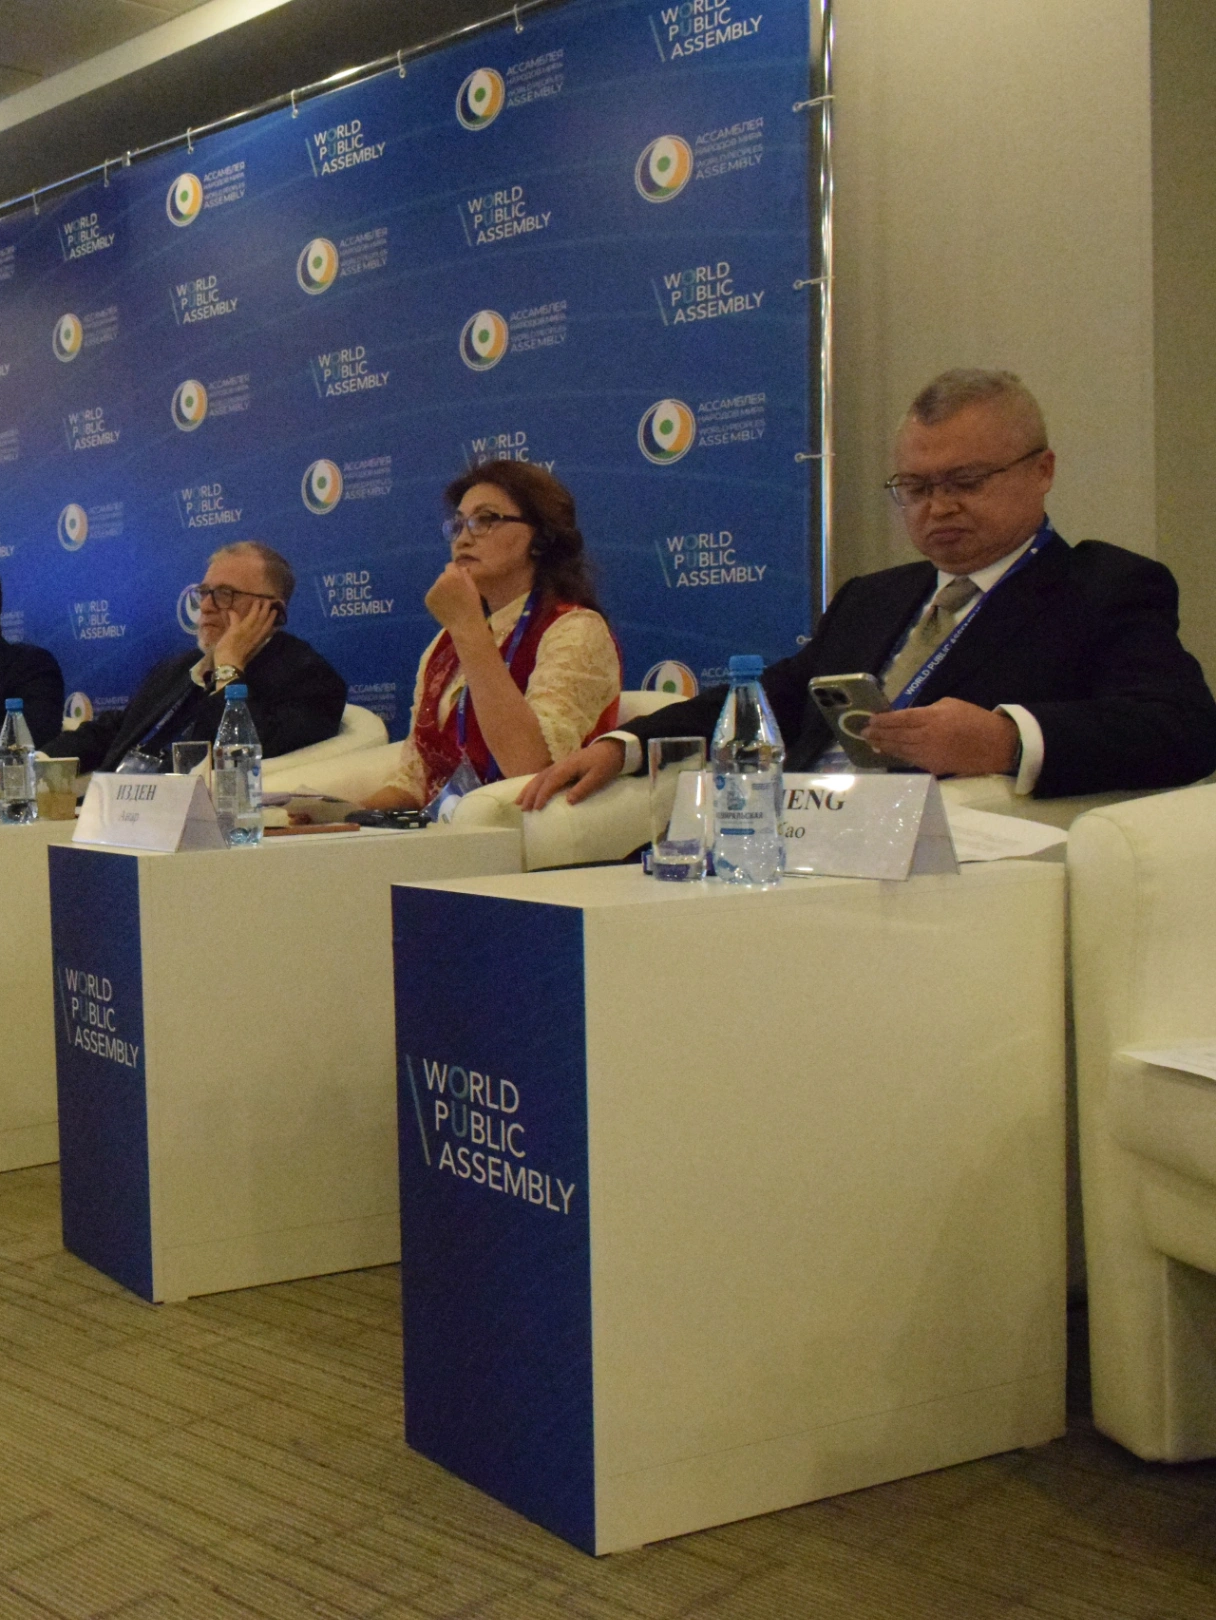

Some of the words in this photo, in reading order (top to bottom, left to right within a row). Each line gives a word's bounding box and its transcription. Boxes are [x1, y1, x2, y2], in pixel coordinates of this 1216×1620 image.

[661, 0, 725, 25] WORLD
[668, 7, 732, 41] PUBLIC
[670, 14, 763, 60] ASSEMBLY
[314, 119, 361, 147] WORLD
[319, 134, 364, 161] PUBLIC
[321, 141, 386, 176] ASSEMBLY
[695, 154, 763, 181] ASSEMBLY
[468, 186, 523, 213] WORLD
[64, 213, 98, 235] WORLD
[474, 202, 526, 230] PUBLIC
[68, 225, 100, 246] PUBLIC
[476, 211, 552, 246] ASSEMBLY
[69, 233, 115, 259] ASSEMBLY
[176, 275, 217, 297] WORLD
[664, 262, 730, 289] WORLD
[181, 289, 219, 311] PUBLIC
[671, 278, 733, 307] PUBLIC
[183, 298, 238, 324] ASSEMBLY
[673, 290, 765, 325] ASSEMBLY
[318, 346, 365, 368] WORLD
[324, 361, 368, 383] PUBLIC
[326, 371, 390, 397] ASSEMBLY
[69, 407, 103, 425] WORLD
[73, 420, 105, 438] PUBLIC
[74, 430, 121, 450] ASSEMBLY
[698, 428, 765, 447] ASSEMBLY
[471, 431, 526, 453] WORLD
[182, 483, 222, 501] WORLD
[186, 497, 224, 514] PUBLIC
[188, 509, 243, 528] ASSEMBLY
[667, 531, 733, 553] WORLD
[674, 549, 737, 569] PUBLIC
[323, 571, 371, 588] WORLD
[676, 564, 767, 588] ASSEMBLY
[329, 586, 372, 603] PUBLIC
[74, 600, 108, 614] WORLD
[331, 599, 394, 618] ASSEMBLY
[78, 613, 111, 627] PUBLIC
[80, 625, 126, 640] ASSEMBLY
[905, 667, 931, 696] WORLD
[65, 967, 113, 1002] WORLD
[71, 996, 116, 1032] PUBLIC
[75, 1025, 139, 1068] ASSEMBLY
[423, 1058, 520, 1113] WORLD
[435, 1099, 526, 1158] PUBLIC
[438, 1141, 575, 1216] ASSEMBLY
